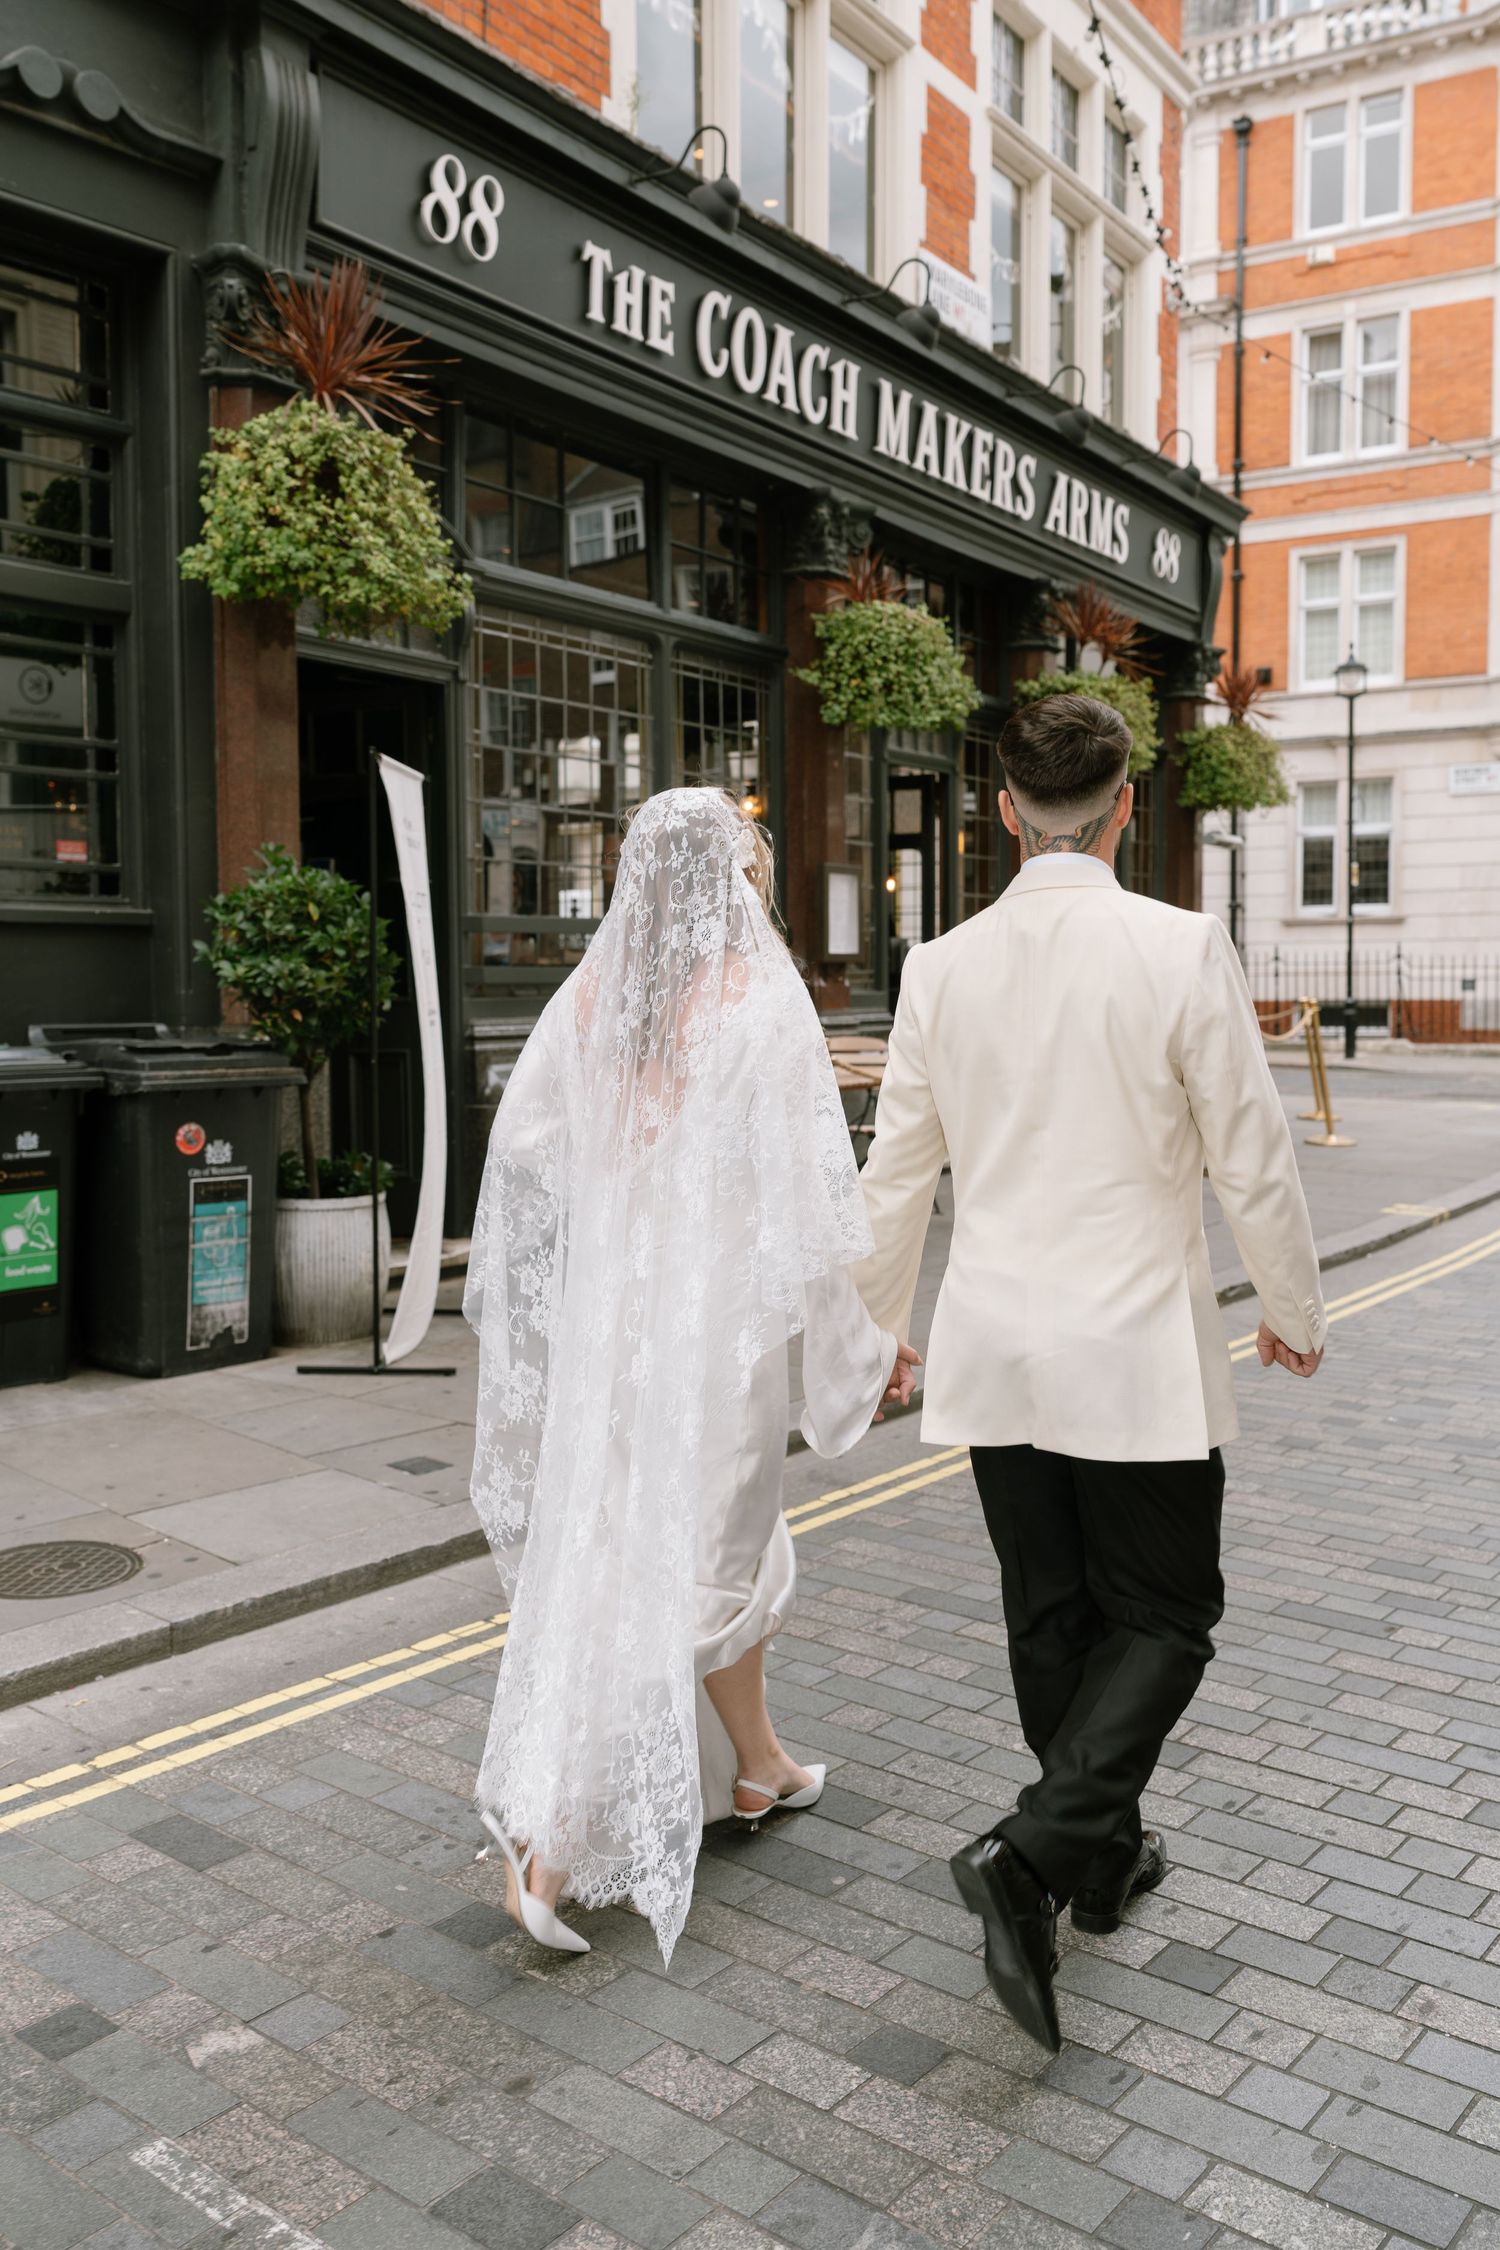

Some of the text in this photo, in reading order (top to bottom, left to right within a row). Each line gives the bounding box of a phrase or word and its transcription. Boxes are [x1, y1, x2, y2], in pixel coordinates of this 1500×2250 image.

[420, 153, 505, 263] 88
[580, 239, 1130, 565] THE COACH MAKERS ARMS
[1151, 526, 1182, 584] 88
